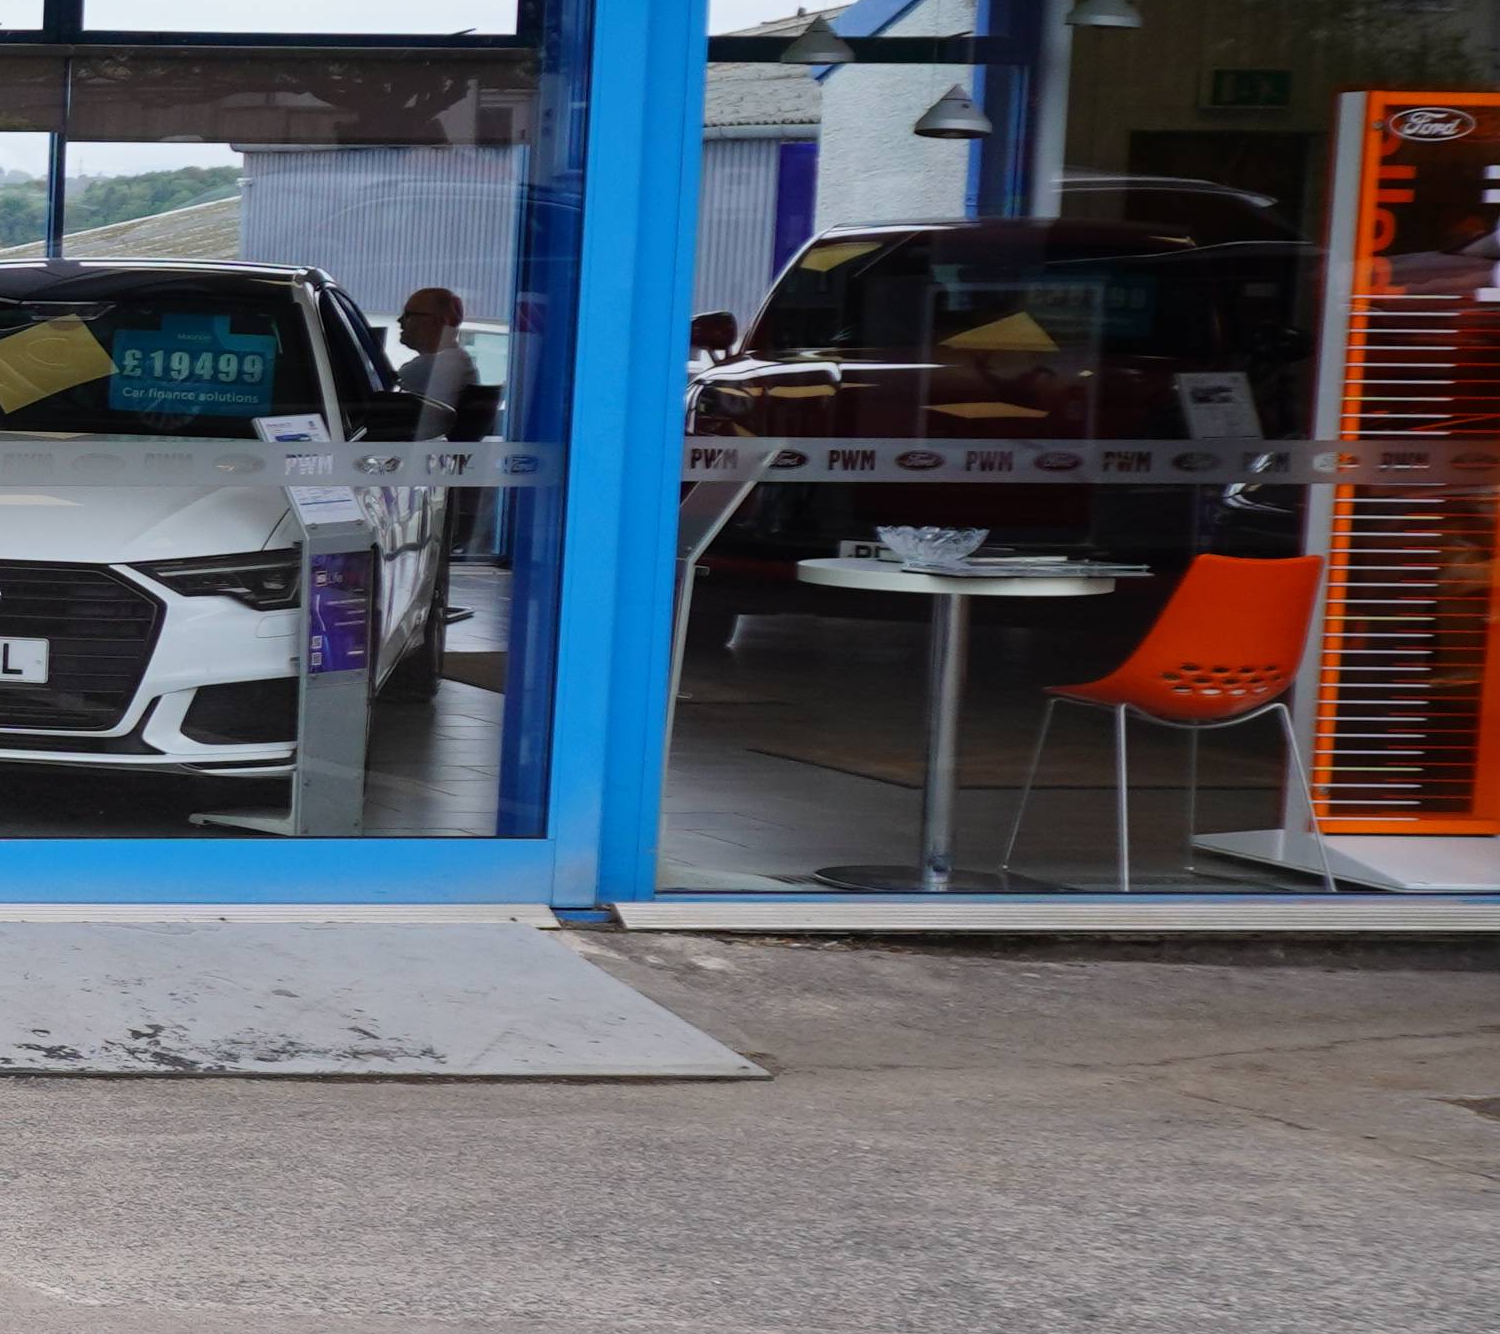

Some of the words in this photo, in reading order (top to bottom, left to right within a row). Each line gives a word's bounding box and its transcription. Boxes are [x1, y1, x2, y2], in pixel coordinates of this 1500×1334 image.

[1404, 111, 1460, 136] Ford
[121, 349, 264, 383] £19499
[122, 387, 145, 398] Car
[148, 387, 196, 400] finance
[198, 391, 260, 404] solutions
[827, 448, 877, 471] PWM
[964, 450, 1014, 473] PWM
